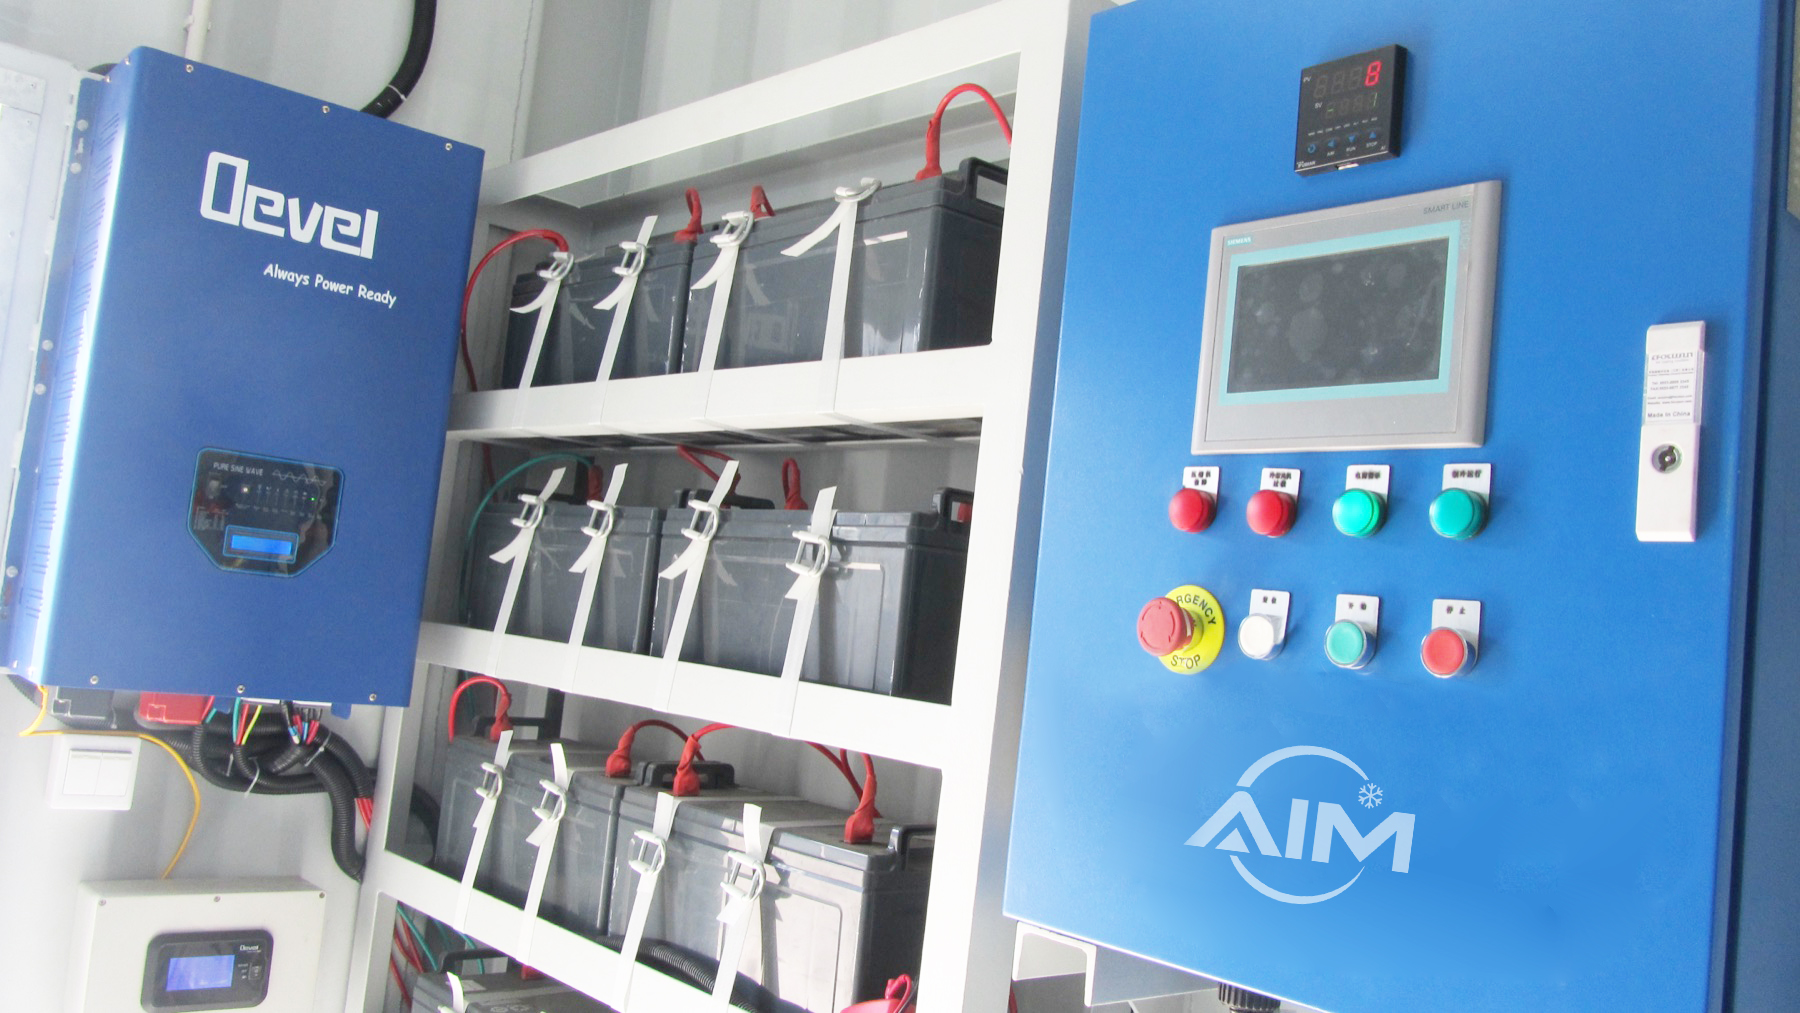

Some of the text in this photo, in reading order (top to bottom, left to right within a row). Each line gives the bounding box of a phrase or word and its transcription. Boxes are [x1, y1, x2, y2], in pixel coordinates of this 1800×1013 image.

[1423, 200, 1469, 215] SMART LINE
[1227, 236, 1252, 246] SIEMENS
[263, 264, 397, 309] Always Power Ready
[213, 462, 229, 471] PURE
[230, 464, 244, 474] SINE
[245, 466, 263, 476] WAVE
[1175, 593, 1217, 626] RGENCY
[1170, 654, 1201, 669] STOP
